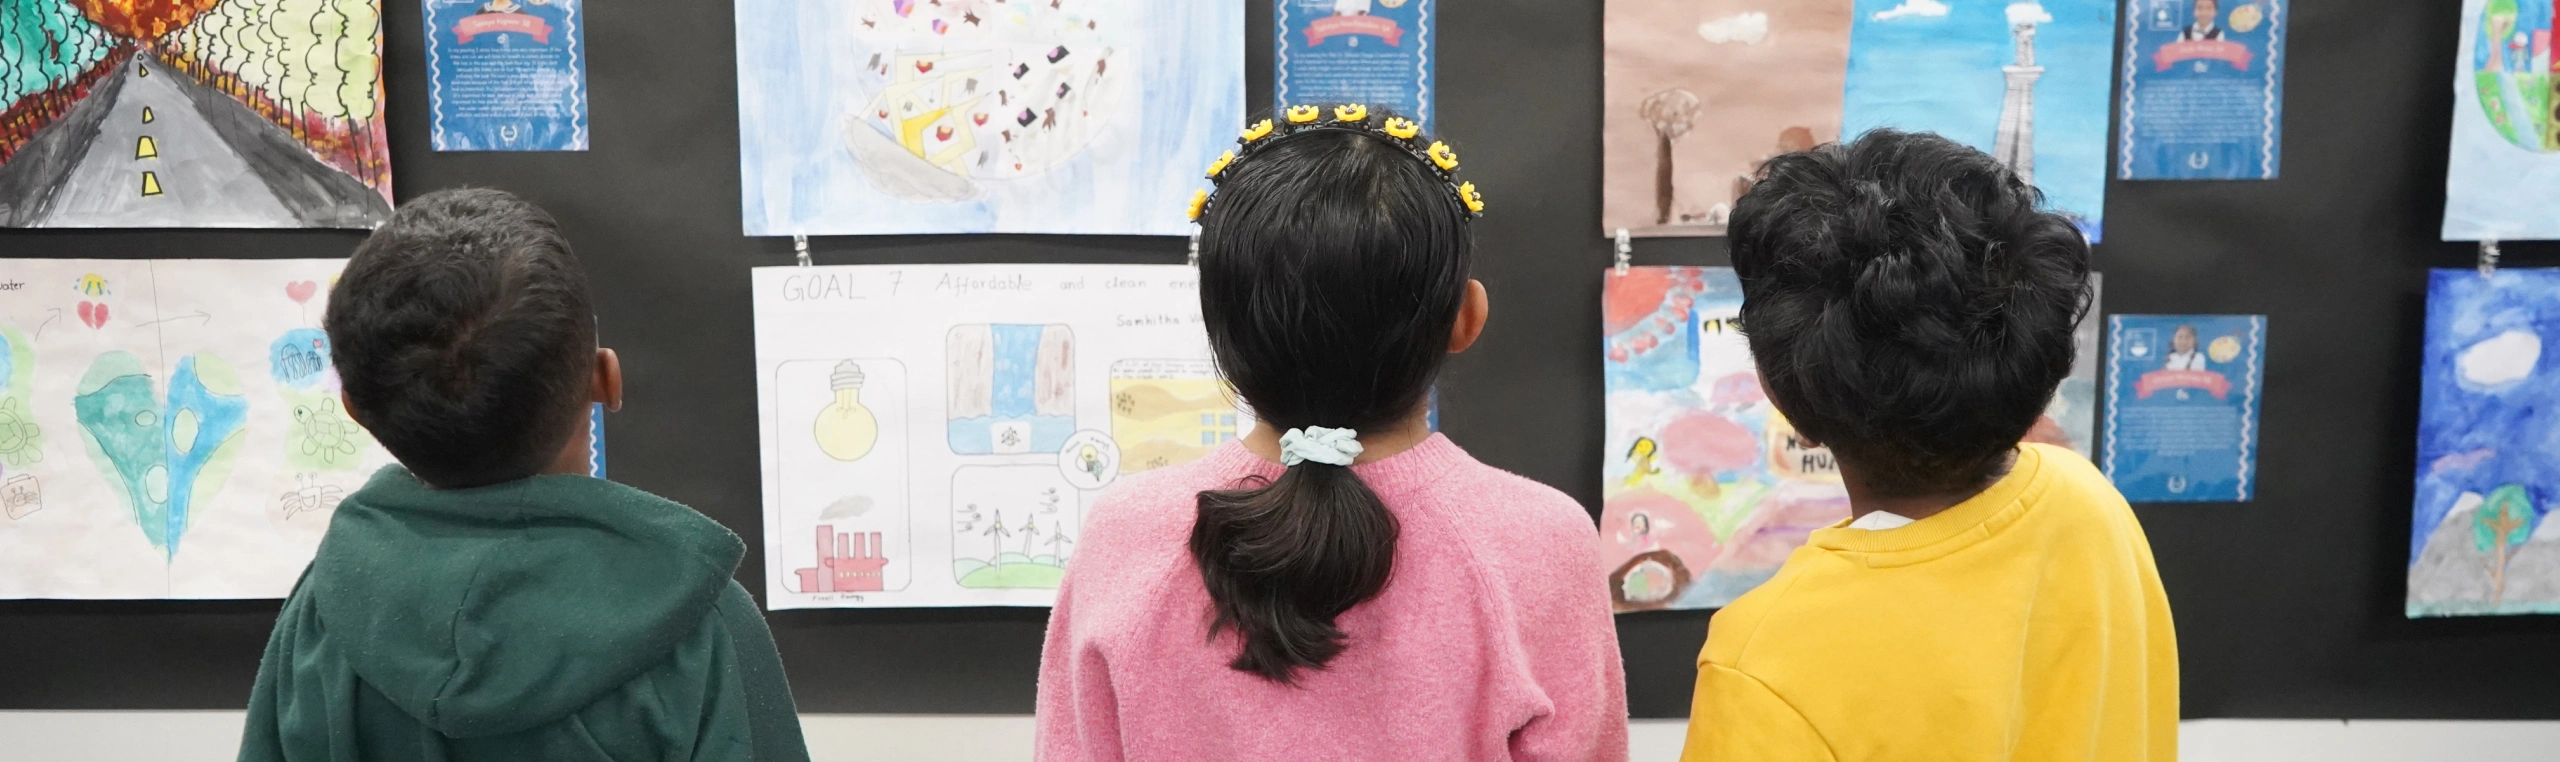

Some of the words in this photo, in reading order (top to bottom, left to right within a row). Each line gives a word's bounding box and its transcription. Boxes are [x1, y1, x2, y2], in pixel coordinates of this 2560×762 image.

[783, 273, 867, 301] GOAL
[889, 271, 904, 296] 7
[935, 272, 1033, 298] Affordable
[1059, 276, 1086, 290] and
[1104, 274, 1148, 290] clean
[1168, 280, 1198, 291] ene
[1116, 313, 1181, 328] Samhitha
